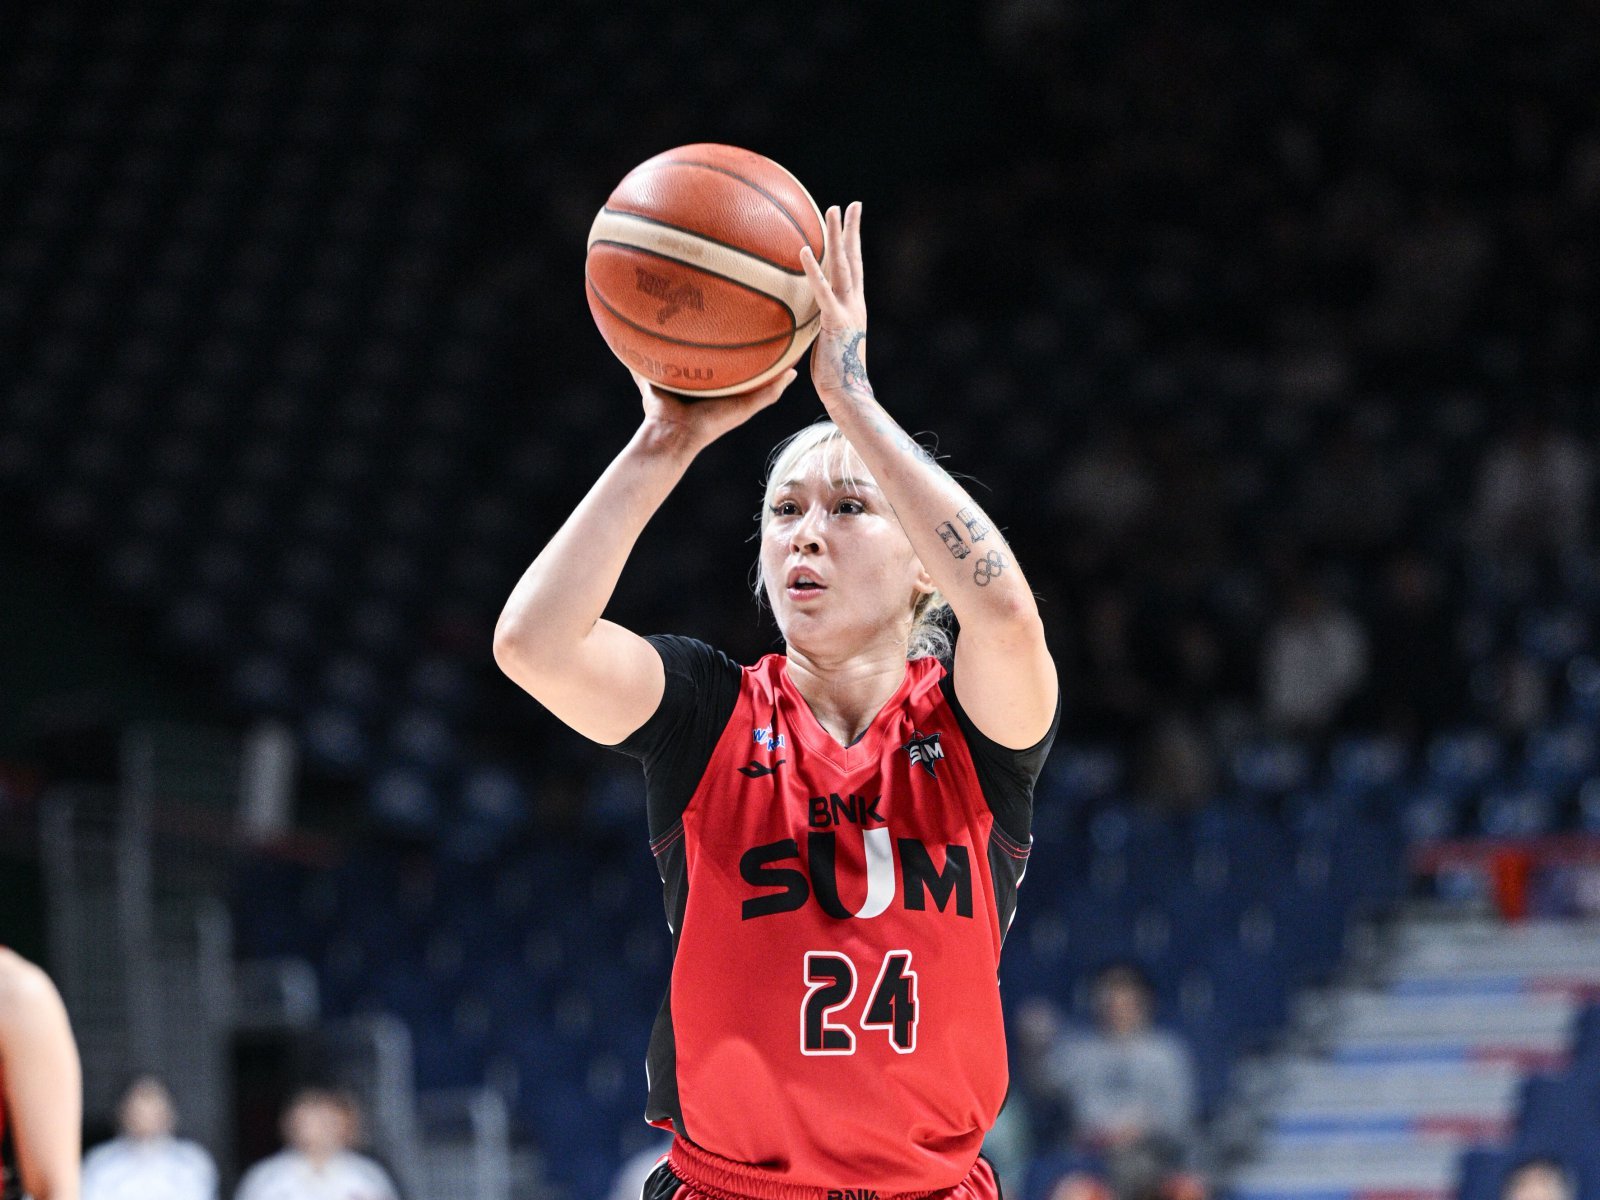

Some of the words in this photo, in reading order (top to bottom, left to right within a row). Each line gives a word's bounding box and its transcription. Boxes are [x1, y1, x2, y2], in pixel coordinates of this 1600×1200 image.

[809, 793, 885, 828] BNK
[740, 827, 974, 921] SUM
[800, 949, 919, 1056] 24
